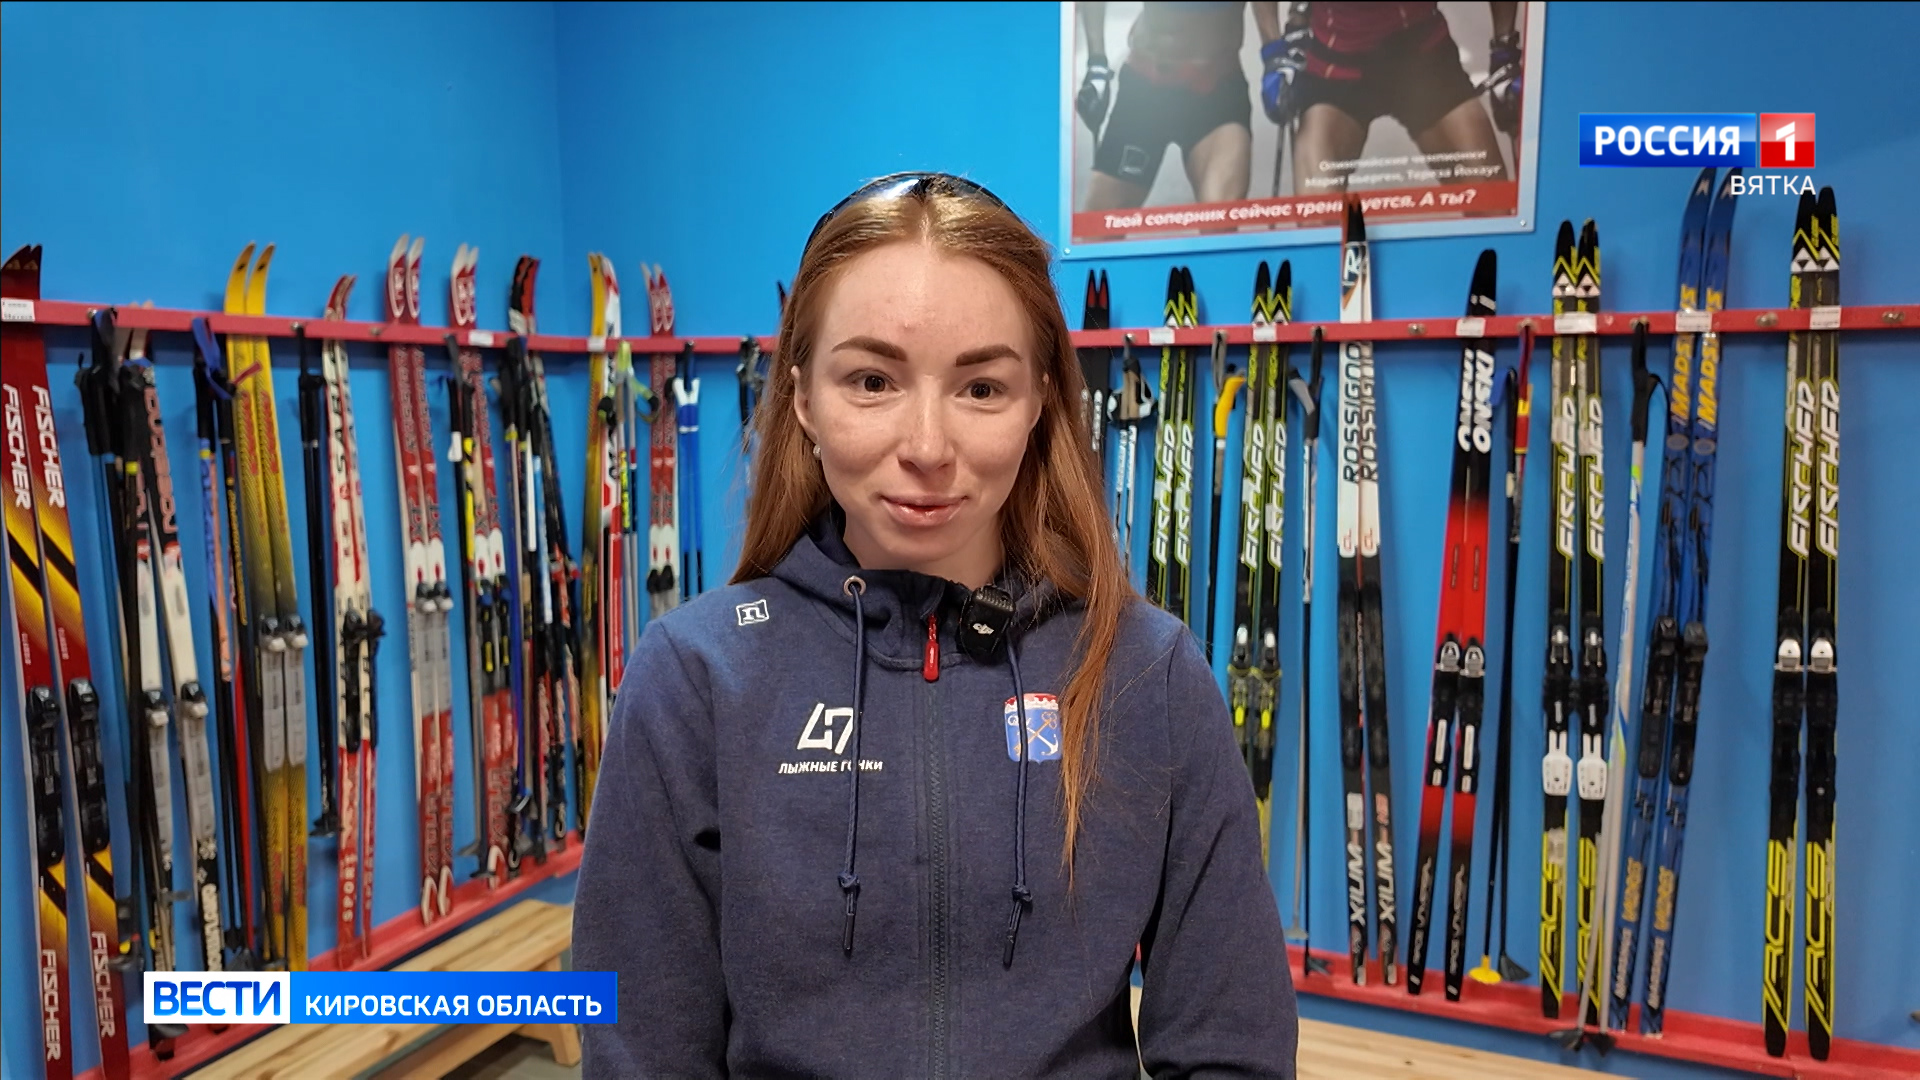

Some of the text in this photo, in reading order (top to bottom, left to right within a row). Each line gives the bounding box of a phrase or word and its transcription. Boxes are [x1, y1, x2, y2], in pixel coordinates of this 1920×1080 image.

[1103, 211, 1143, 230] Твой
[1144, 206, 1227, 229] соперник
[1229, 201, 1292, 220] сейчас
[1419, 191, 1435, 207] А
[1439, 188, 1477, 206] ты?
[2, 383, 32, 510] FISCHER
[32, 384, 65, 509] FISCHER
[1789, 380, 1814, 558] FISCHER
[1818, 380, 1840, 559] FISCHER
[778, 760, 839, 775] ЛЫЖНЫЕ
[1347, 841, 1367, 926] XIUM
[1376, 840, 1395, 925] XIUM
[41, 948, 61, 1062] FISCHER
[92, 930, 116, 1039] FISCHER
